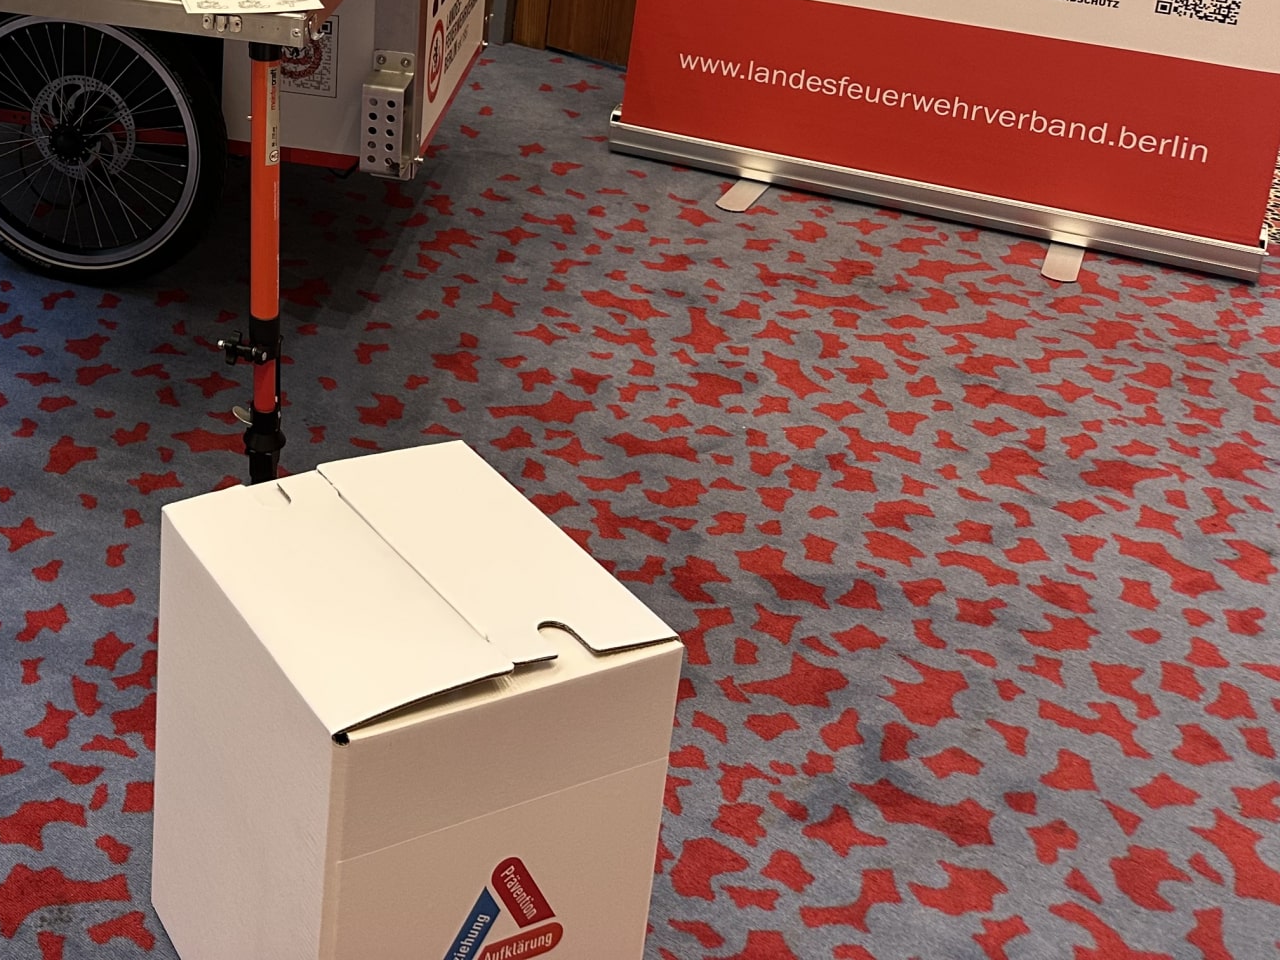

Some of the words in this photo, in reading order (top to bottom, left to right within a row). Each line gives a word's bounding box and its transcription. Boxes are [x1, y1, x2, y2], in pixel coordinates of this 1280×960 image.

[679, 51, 1210, 164] www.landesfeuerwehrverband.berlin
[500, 865, 537, 920] Prävention
[452, 914, 491, 960] ziehung
